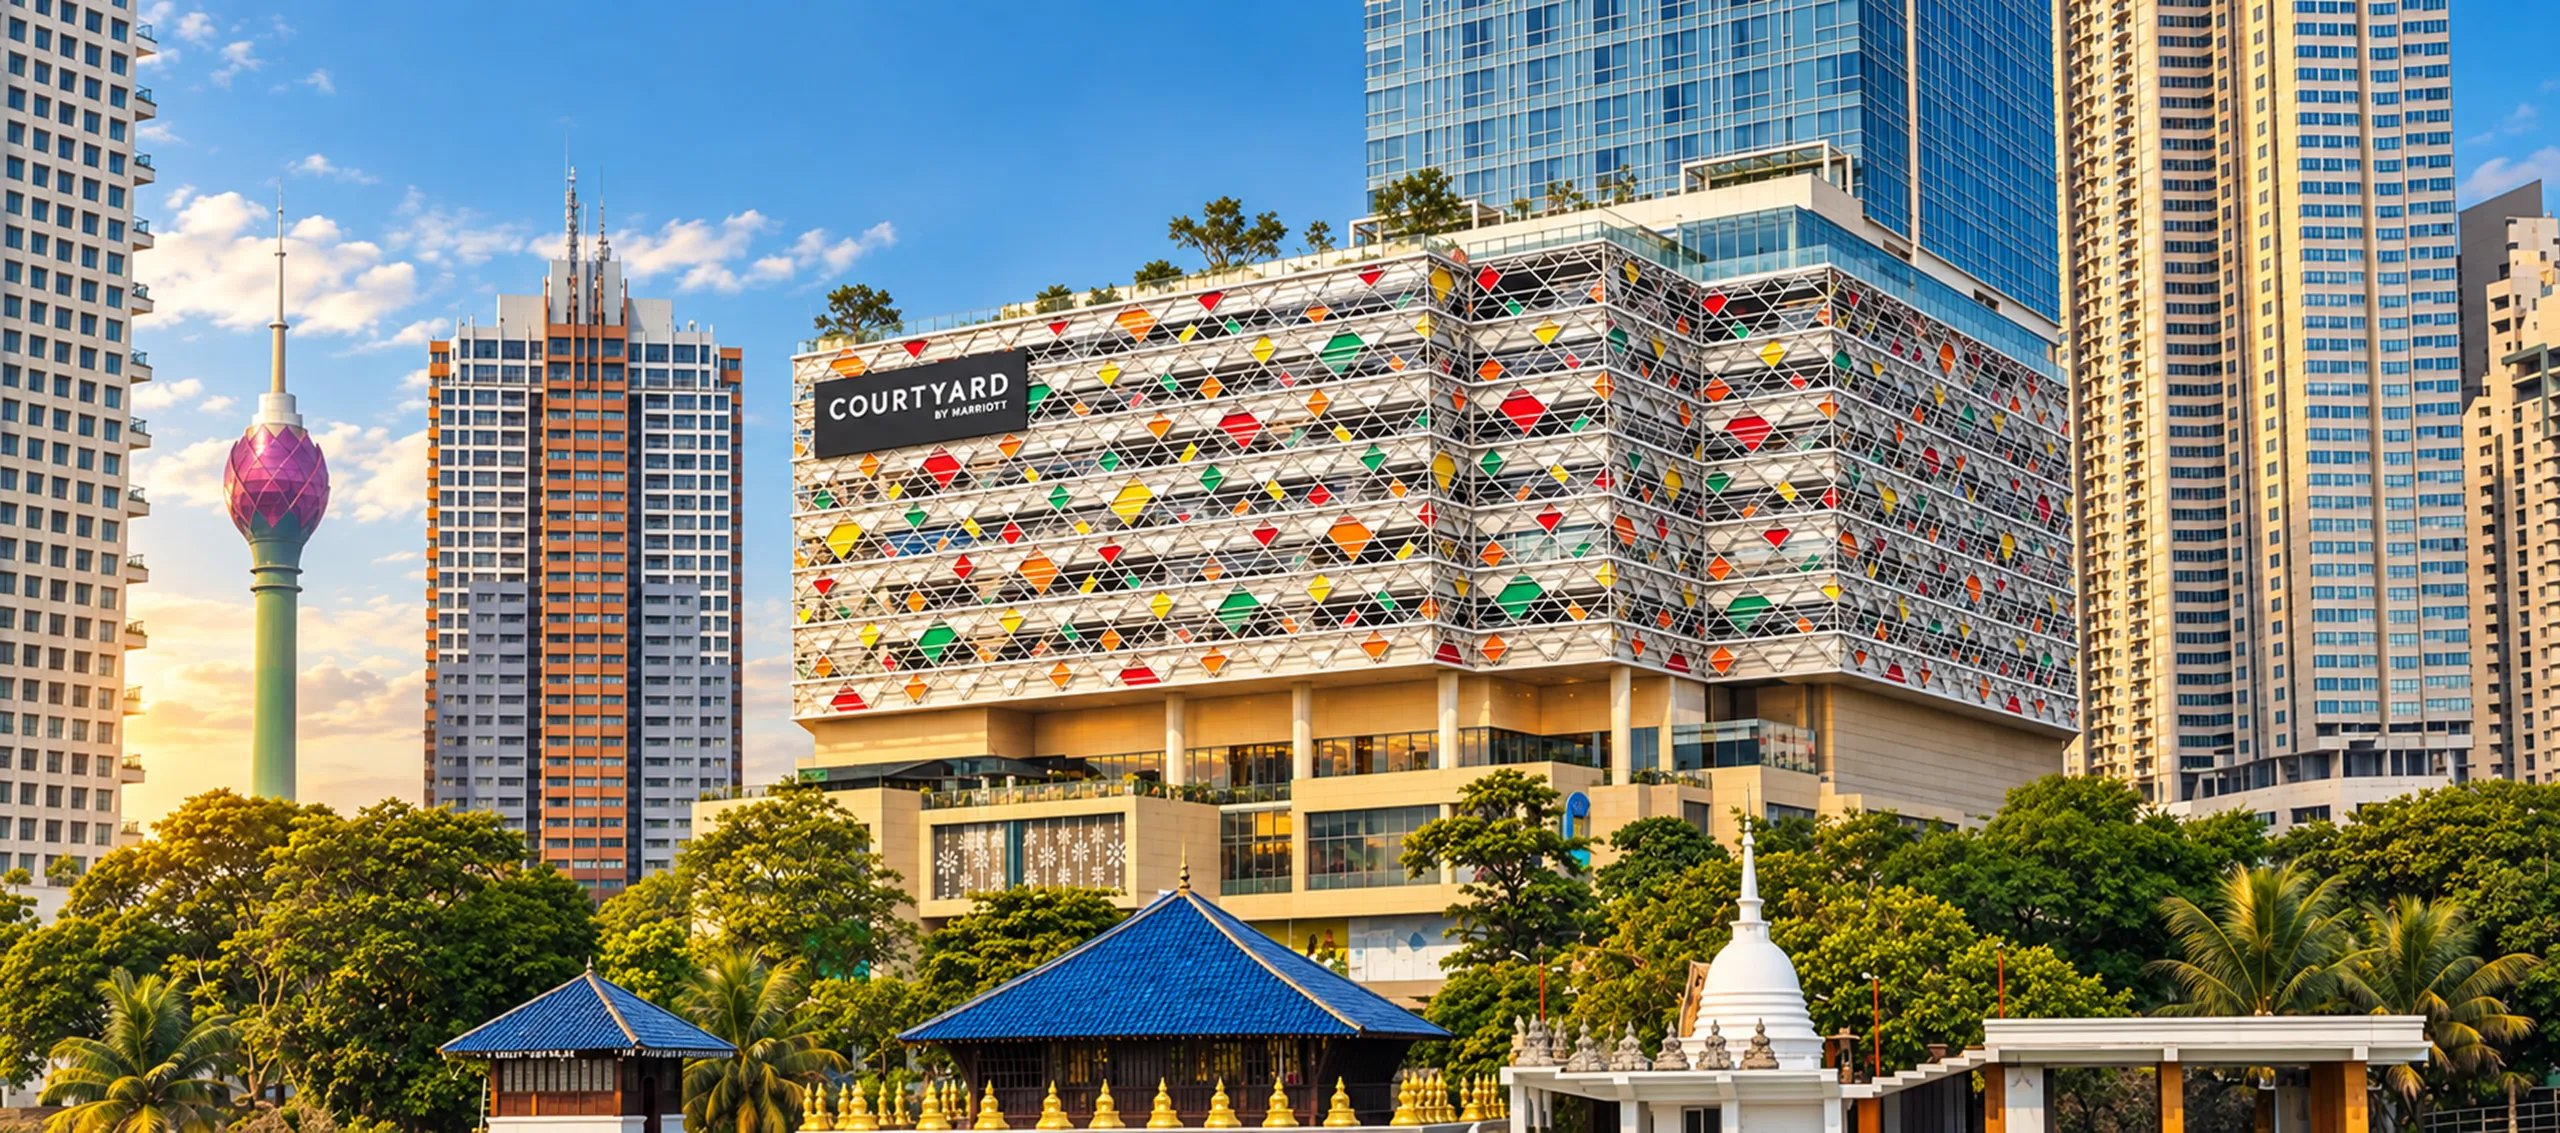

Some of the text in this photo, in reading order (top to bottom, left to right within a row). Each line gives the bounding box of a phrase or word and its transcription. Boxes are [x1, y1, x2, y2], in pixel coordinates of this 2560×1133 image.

[829, 373, 1008, 420] COURTYARD
[934, 400, 1008, 420] BY MARRIOTT
